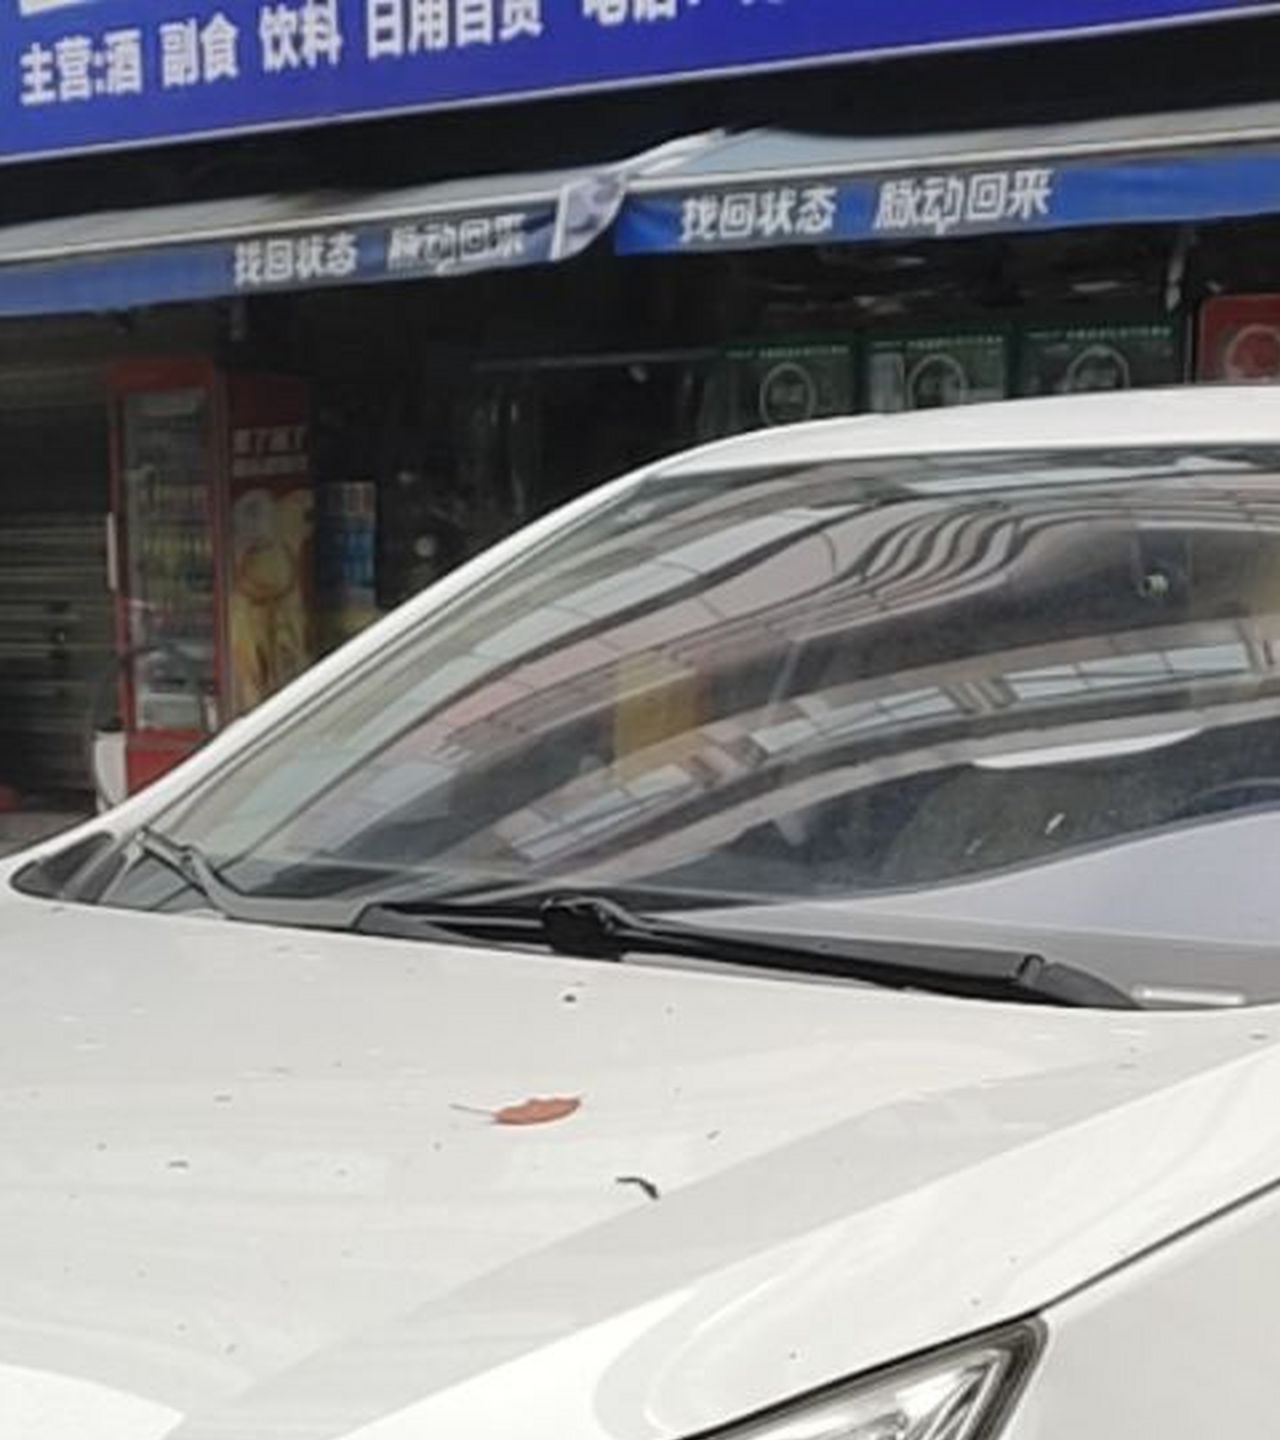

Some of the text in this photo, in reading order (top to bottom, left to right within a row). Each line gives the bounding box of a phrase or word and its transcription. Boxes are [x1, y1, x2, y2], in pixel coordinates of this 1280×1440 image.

[159, 13, 239, 88] 副食
[259, 0, 343, 72] 饮料
[678, 168, 1053, 244] 找回状态 脉动回来
[234, 232, 358, 287] 找回状态
